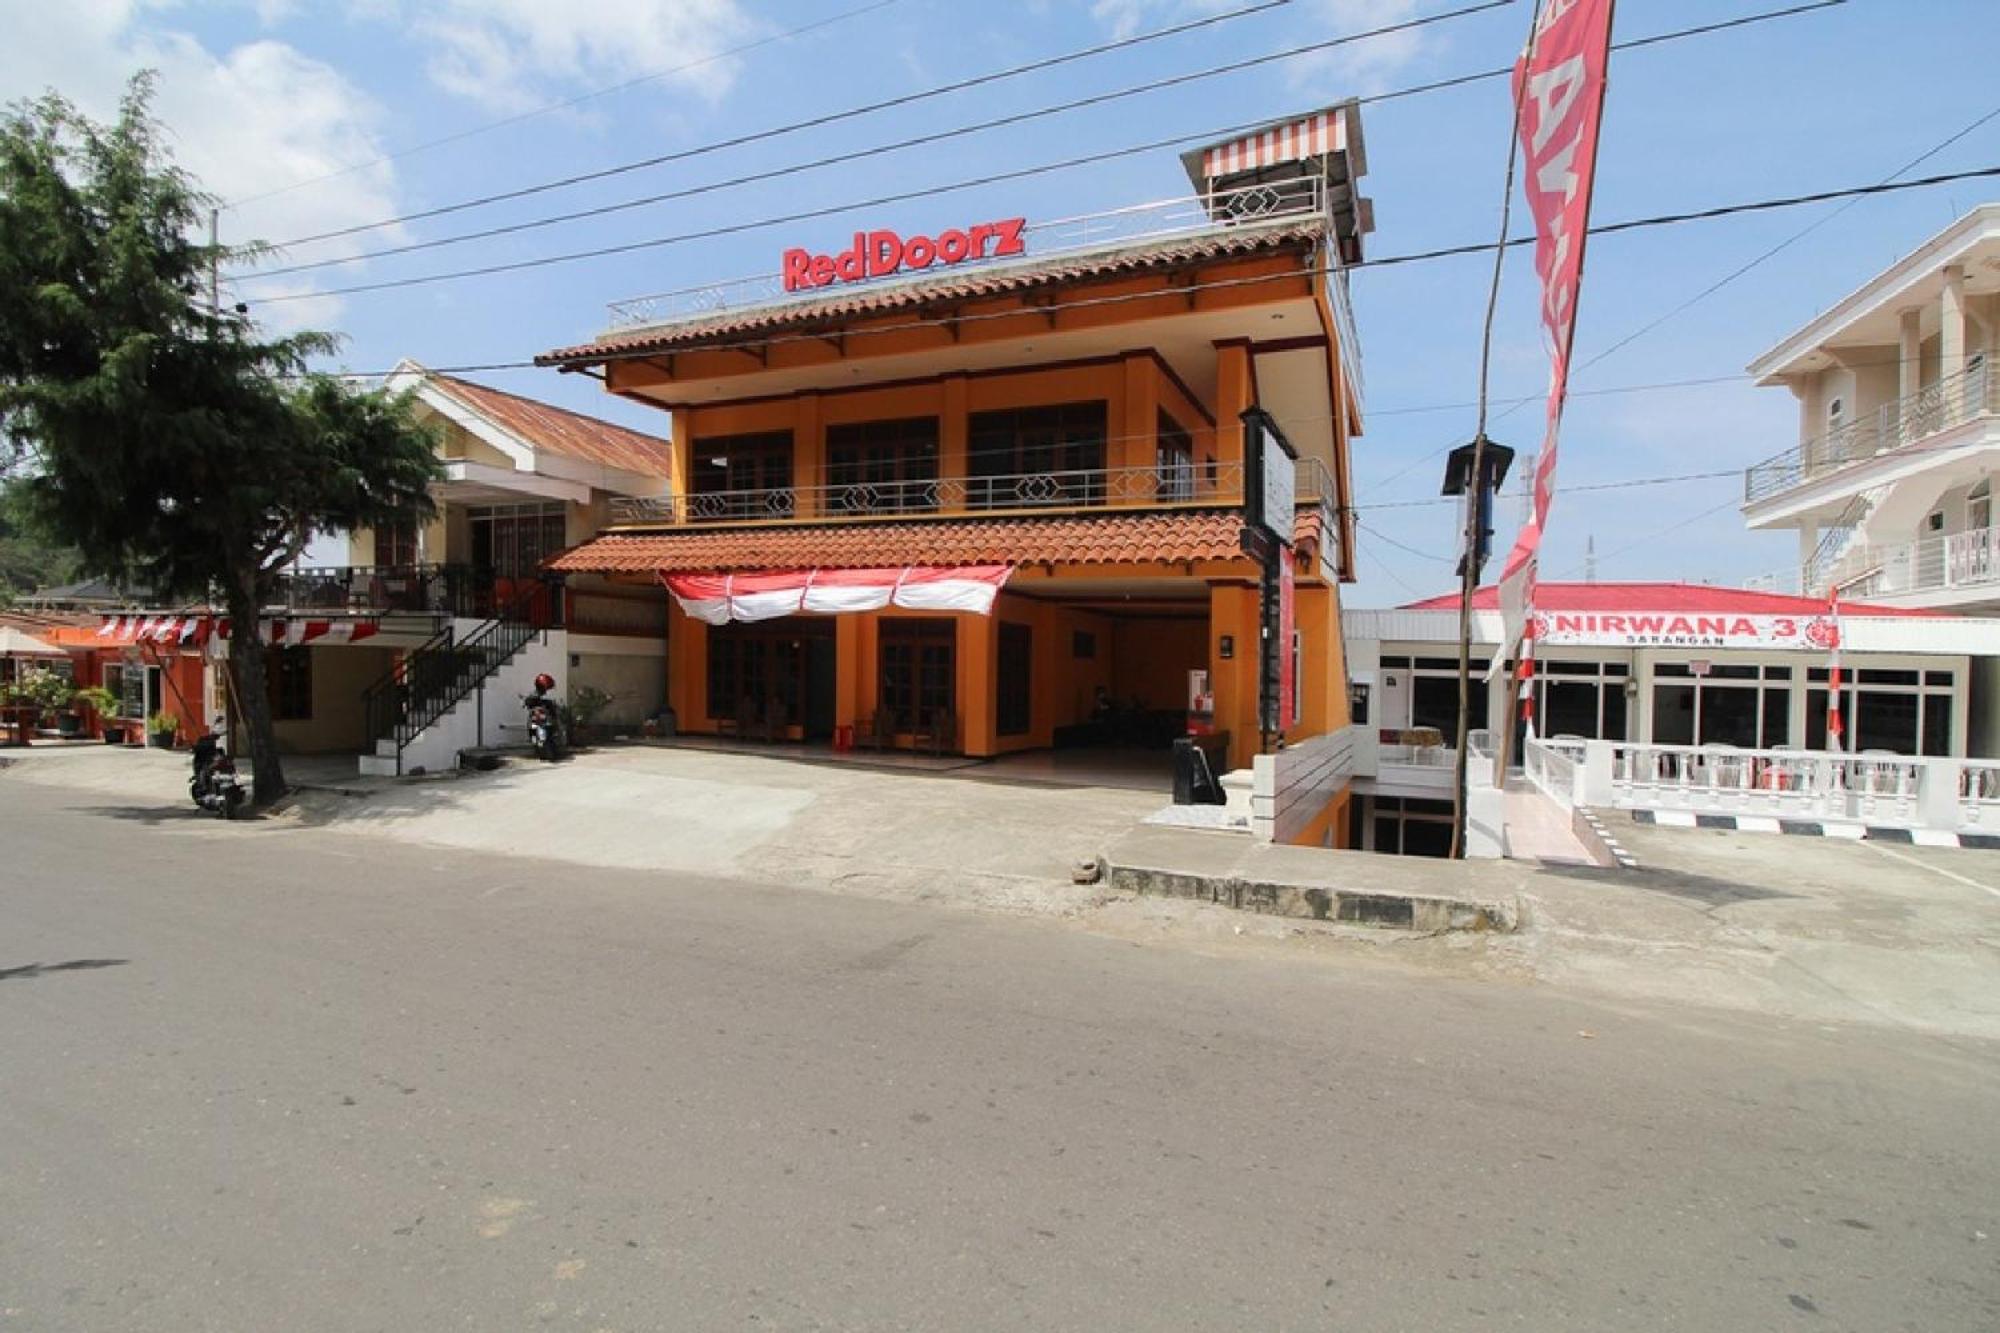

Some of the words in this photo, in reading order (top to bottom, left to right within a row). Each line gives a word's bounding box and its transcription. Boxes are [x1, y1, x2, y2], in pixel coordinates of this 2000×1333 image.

[783, 217, 1026, 292] RedDoorz
[1556, 615, 1757, 636] NIRWANA
[1774, 619, 1796, 637] 3
